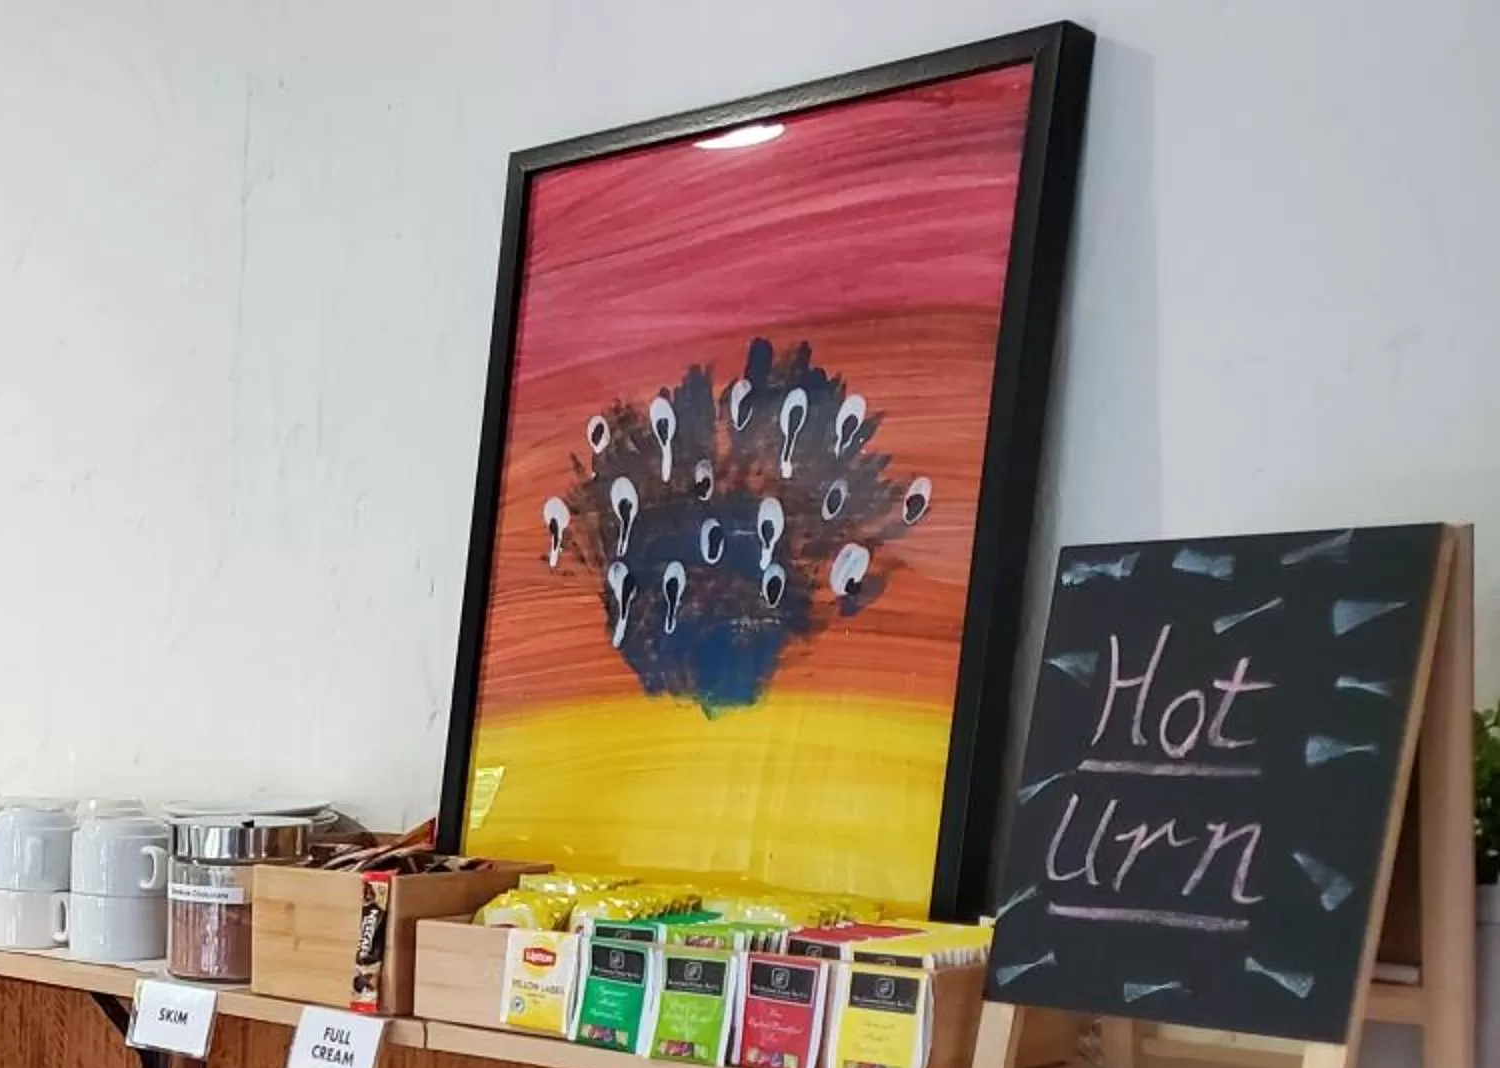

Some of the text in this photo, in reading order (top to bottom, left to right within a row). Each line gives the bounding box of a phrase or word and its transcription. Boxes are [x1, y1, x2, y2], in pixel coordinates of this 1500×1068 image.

[1092, 624, 1276, 759] Hot
[1044, 793, 1265, 904] Urn
[158, 1007, 189, 1025] SKIM
[323, 1027, 351, 1045] FULL
[311, 1044, 355, 1068] CREAM
